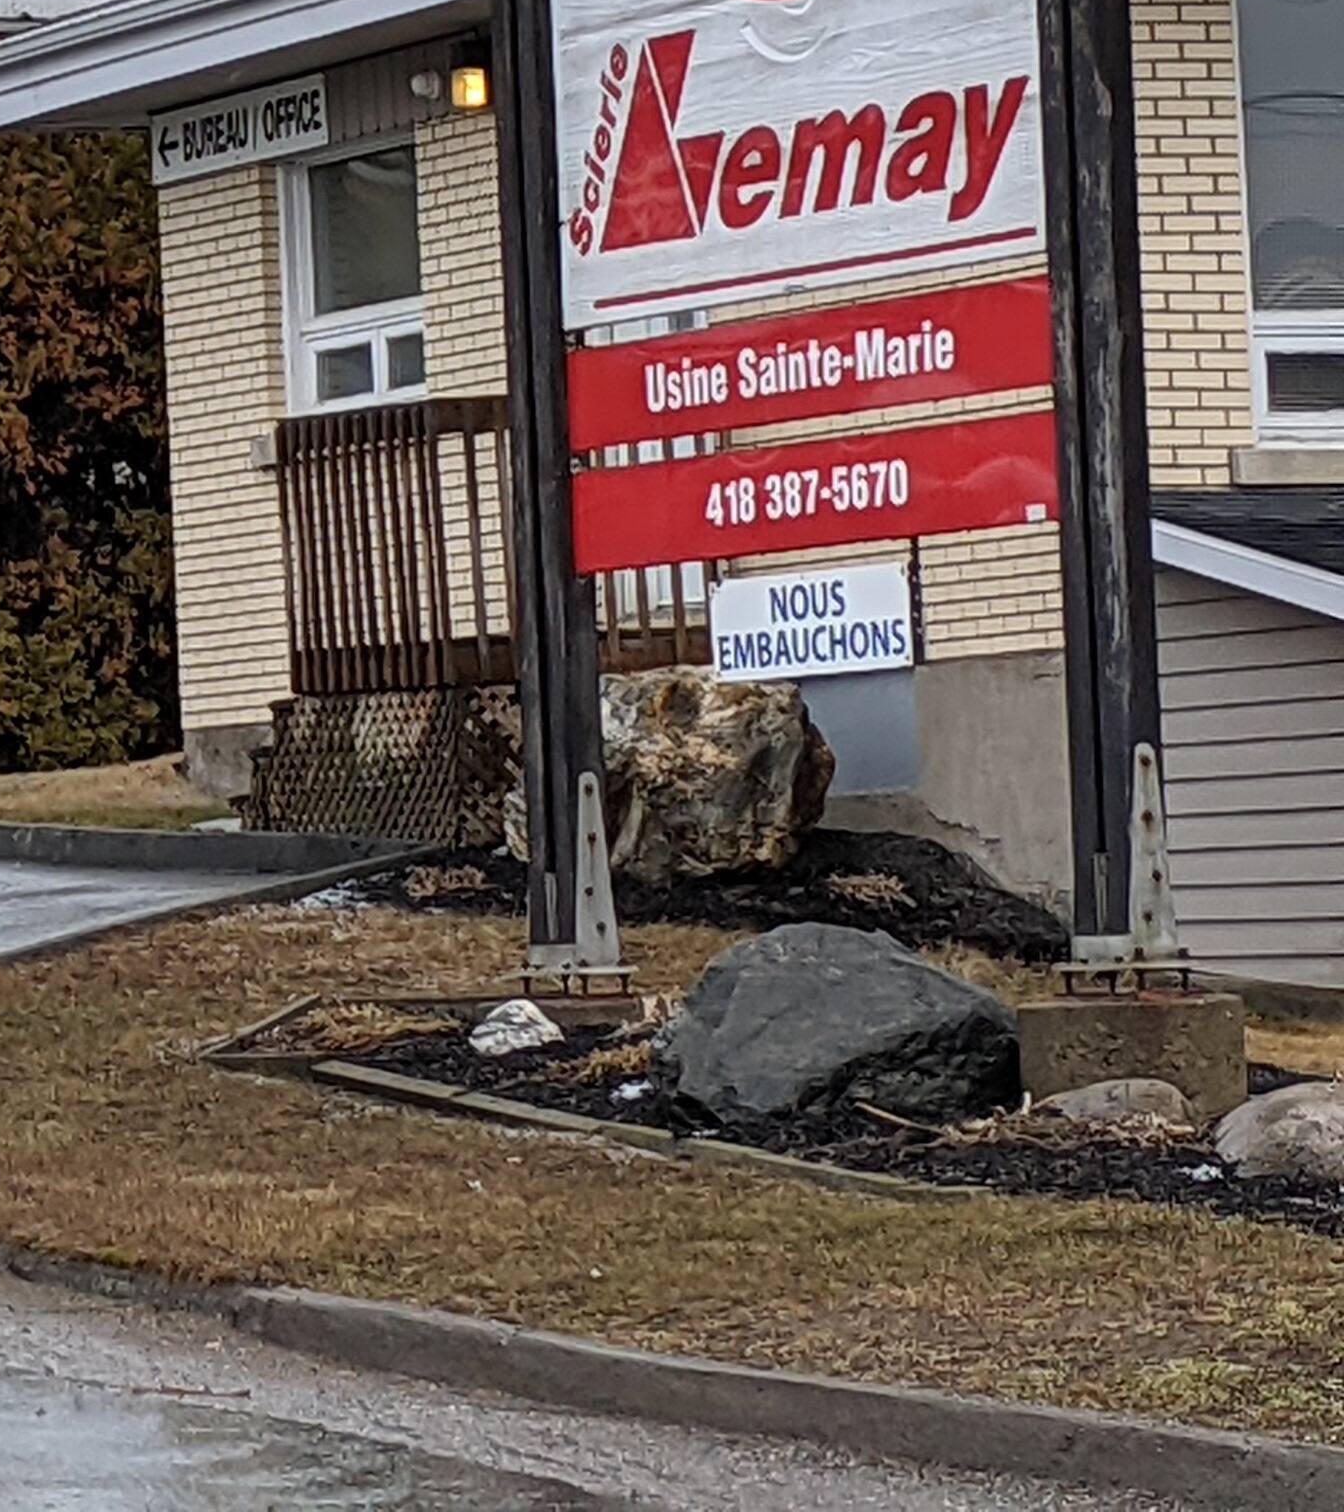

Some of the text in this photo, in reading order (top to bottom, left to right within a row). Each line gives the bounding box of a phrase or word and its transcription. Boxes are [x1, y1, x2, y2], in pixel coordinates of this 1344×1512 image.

[182, 107, 248, 161] BUREAU
[263, 89, 321, 142] OFFICE
[570, 42, 629, 256] Scierie
[599, 29, 1030, 253] Lemay
[645, 320, 955, 413] Usine Sainte-Marie
[705, 459, 910, 527] 418 387-5670
[769, 580, 846, 624] NOUS
[718, 619, 906, 671] EMBAUCHONS
